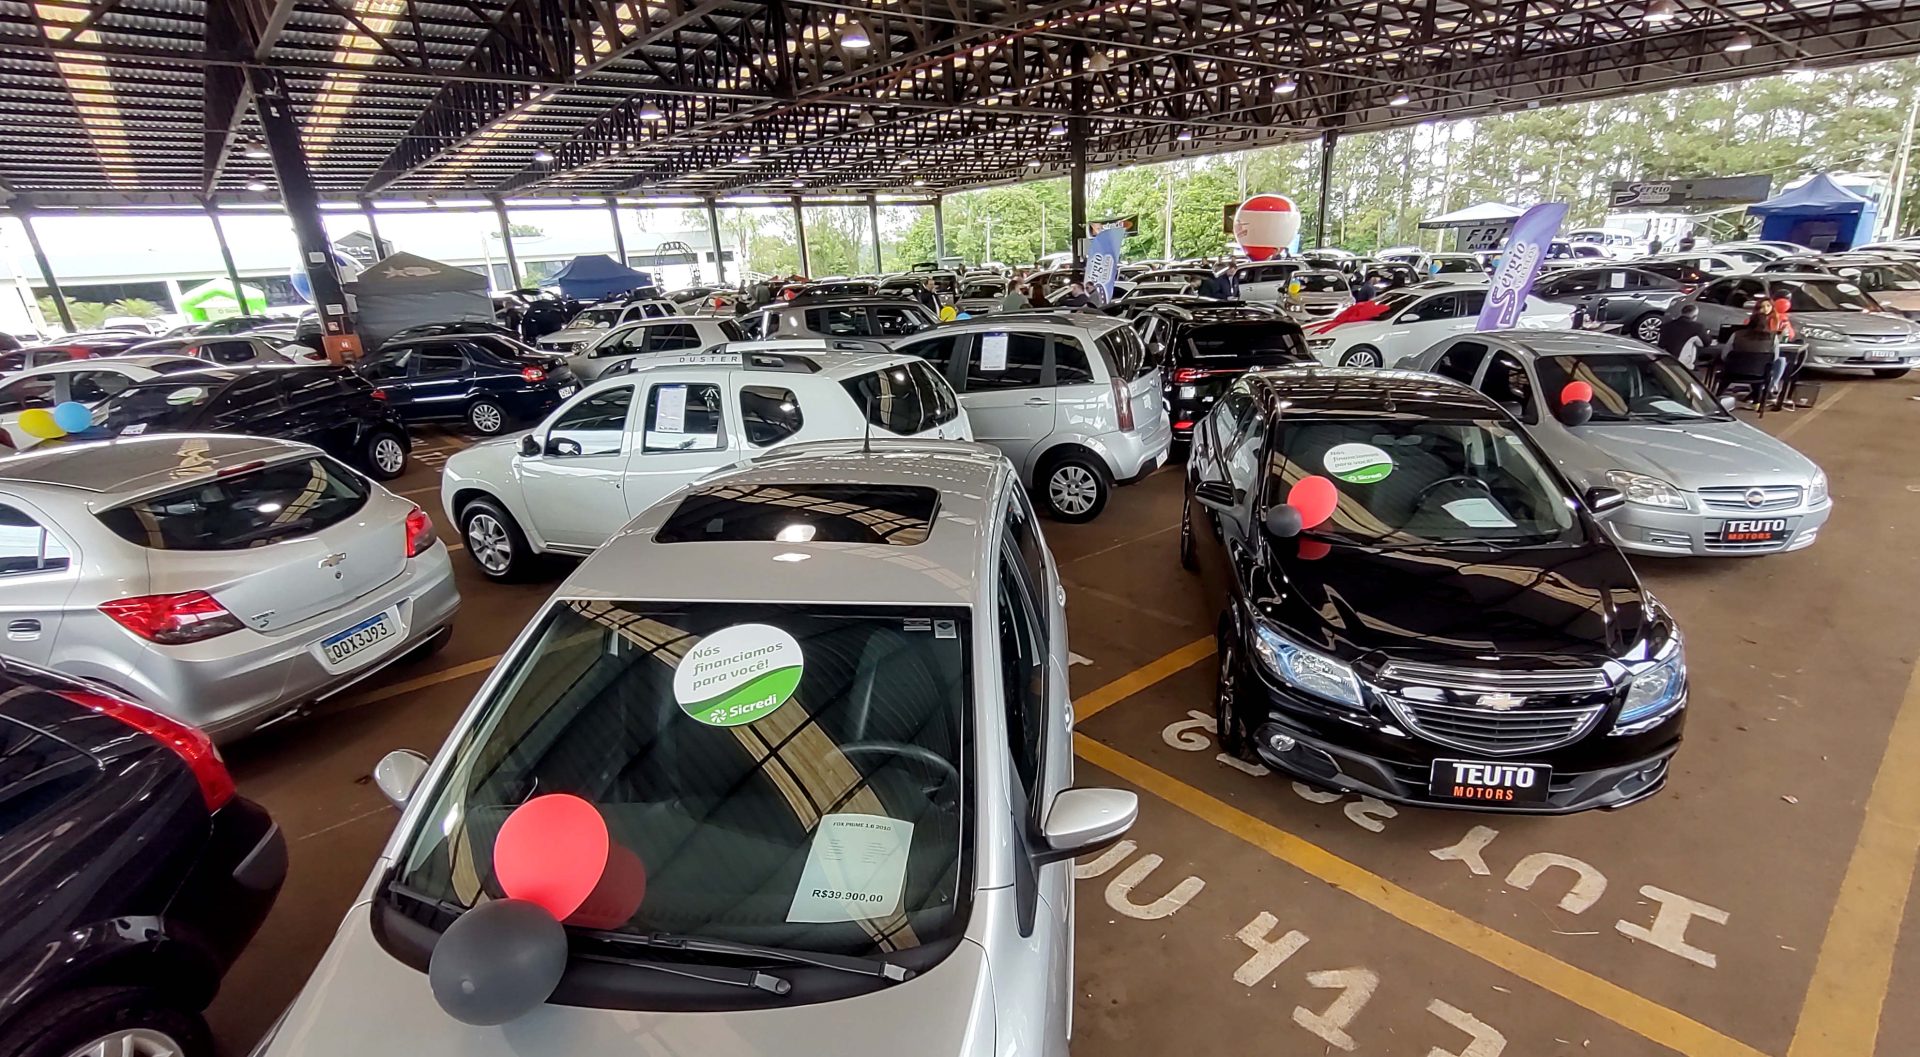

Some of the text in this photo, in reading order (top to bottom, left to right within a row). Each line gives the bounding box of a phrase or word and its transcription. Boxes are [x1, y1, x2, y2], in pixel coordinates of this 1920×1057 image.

[1727, 520, 1785, 532] TEUTO
[1728, 532, 1772, 540] MOTORS
[332, 622, 388, 658] QQX3J93
[692, 646, 721, 660] Nós
[693, 642, 783, 677] financiamos
[693, 659, 769, 691] para você!
[729, 694, 777, 718] Sicredi
[1453, 763, 1535, 788] TEUTO
[1453, 786, 1514, 800] MOTORS
[812, 889, 883, 903] R$39.900,00
